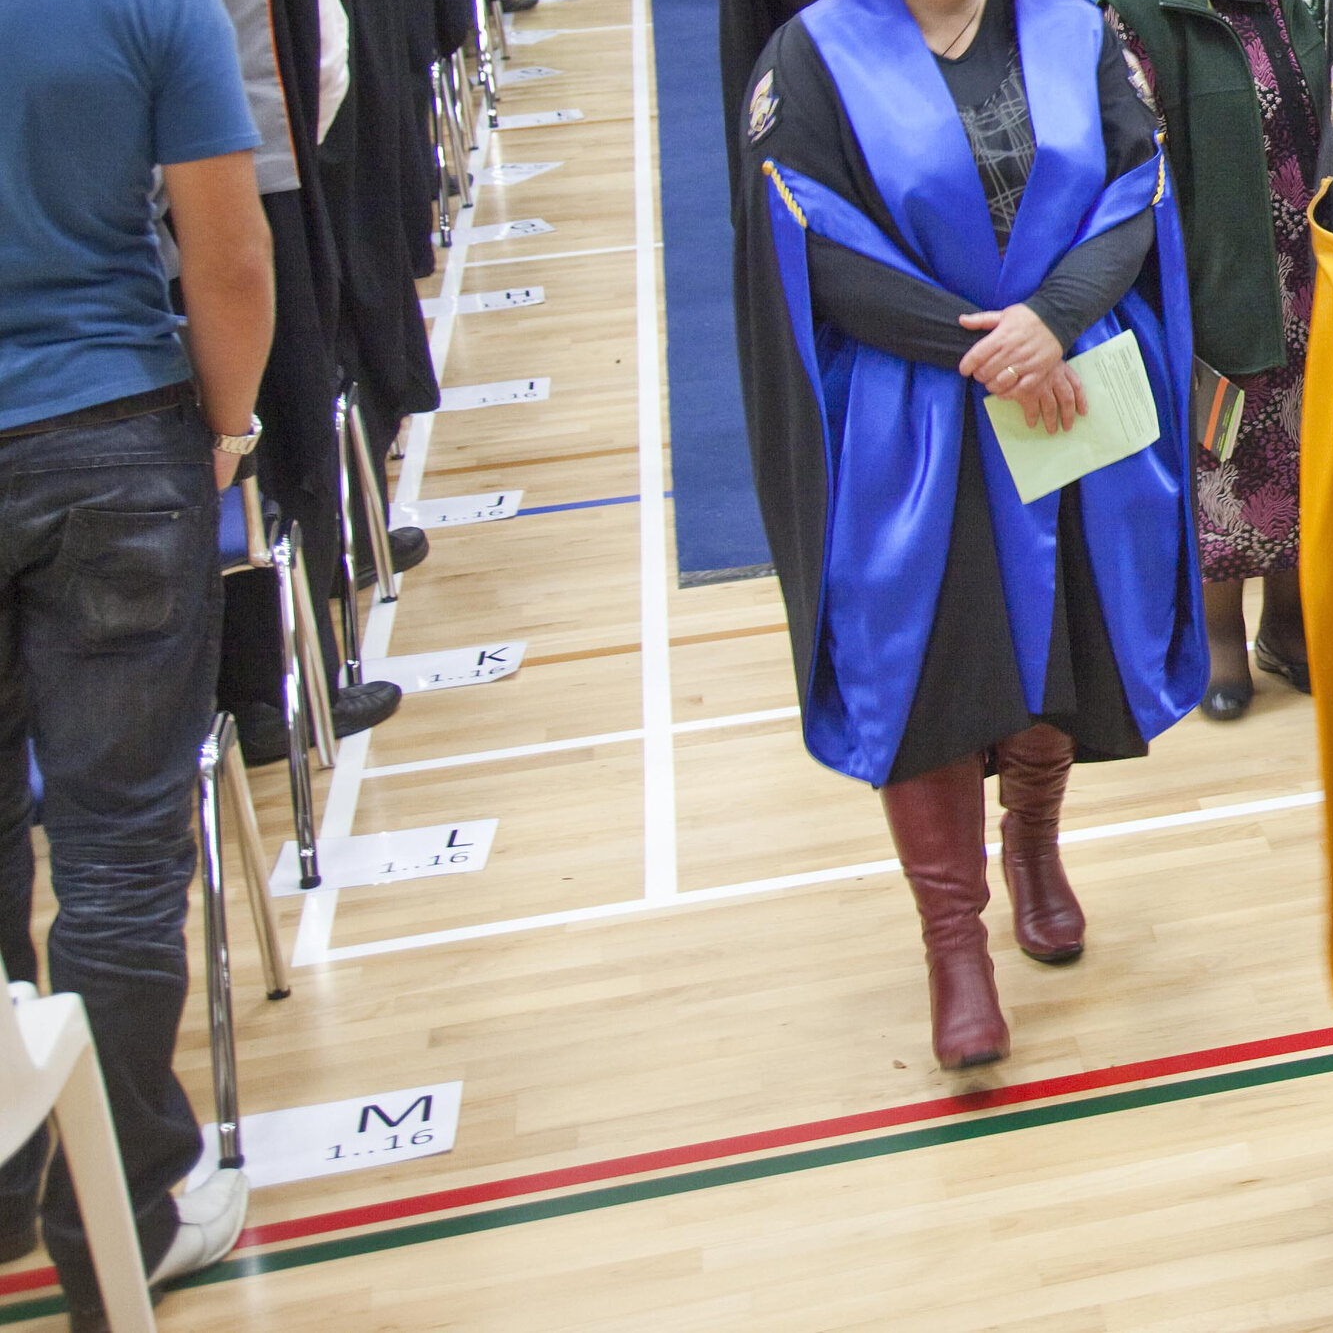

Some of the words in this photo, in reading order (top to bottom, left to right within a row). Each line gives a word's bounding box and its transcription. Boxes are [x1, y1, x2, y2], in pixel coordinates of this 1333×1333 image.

[487, 495, 504, 508] J
[437, 510, 505, 522] 1..16
[477, 646, 509, 666] K
[429, 666, 506, 683] 1..16
[446, 829, 474, 848] L
[379, 851, 470, 874] 1..16
[357, 1095, 433, 1134] M
[325, 1128, 435, 1161] 1..16
